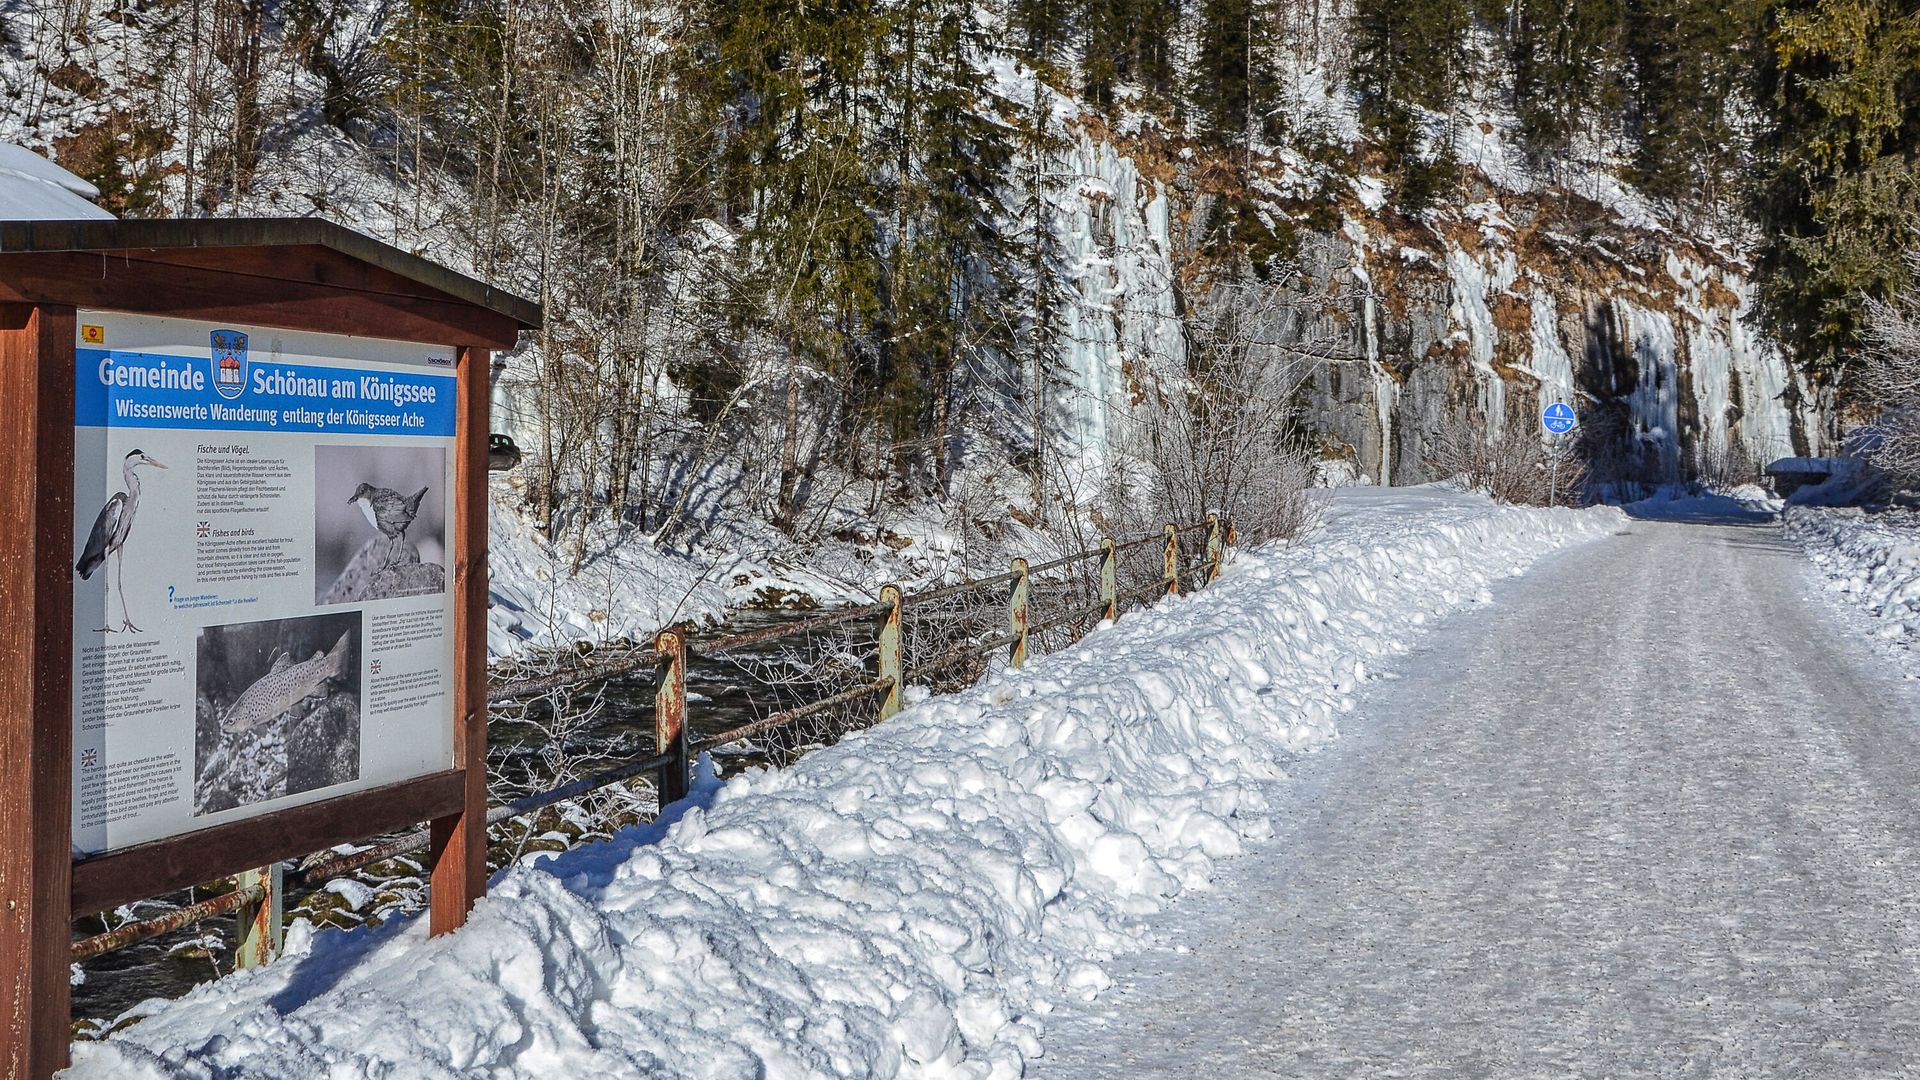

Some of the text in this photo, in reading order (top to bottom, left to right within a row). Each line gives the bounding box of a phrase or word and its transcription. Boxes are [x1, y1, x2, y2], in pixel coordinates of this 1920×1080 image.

[99, 358, 436, 407] Gemeinde Schönau am Königssee
[115, 399, 425, 429] Wissenswerte Wanderung entlang der Königsseer Ache
[196, 445, 250, 456] Fische und Vögel.
[212, 528, 255, 538] Fishes and birds
[168, 586, 176, 603] ?
